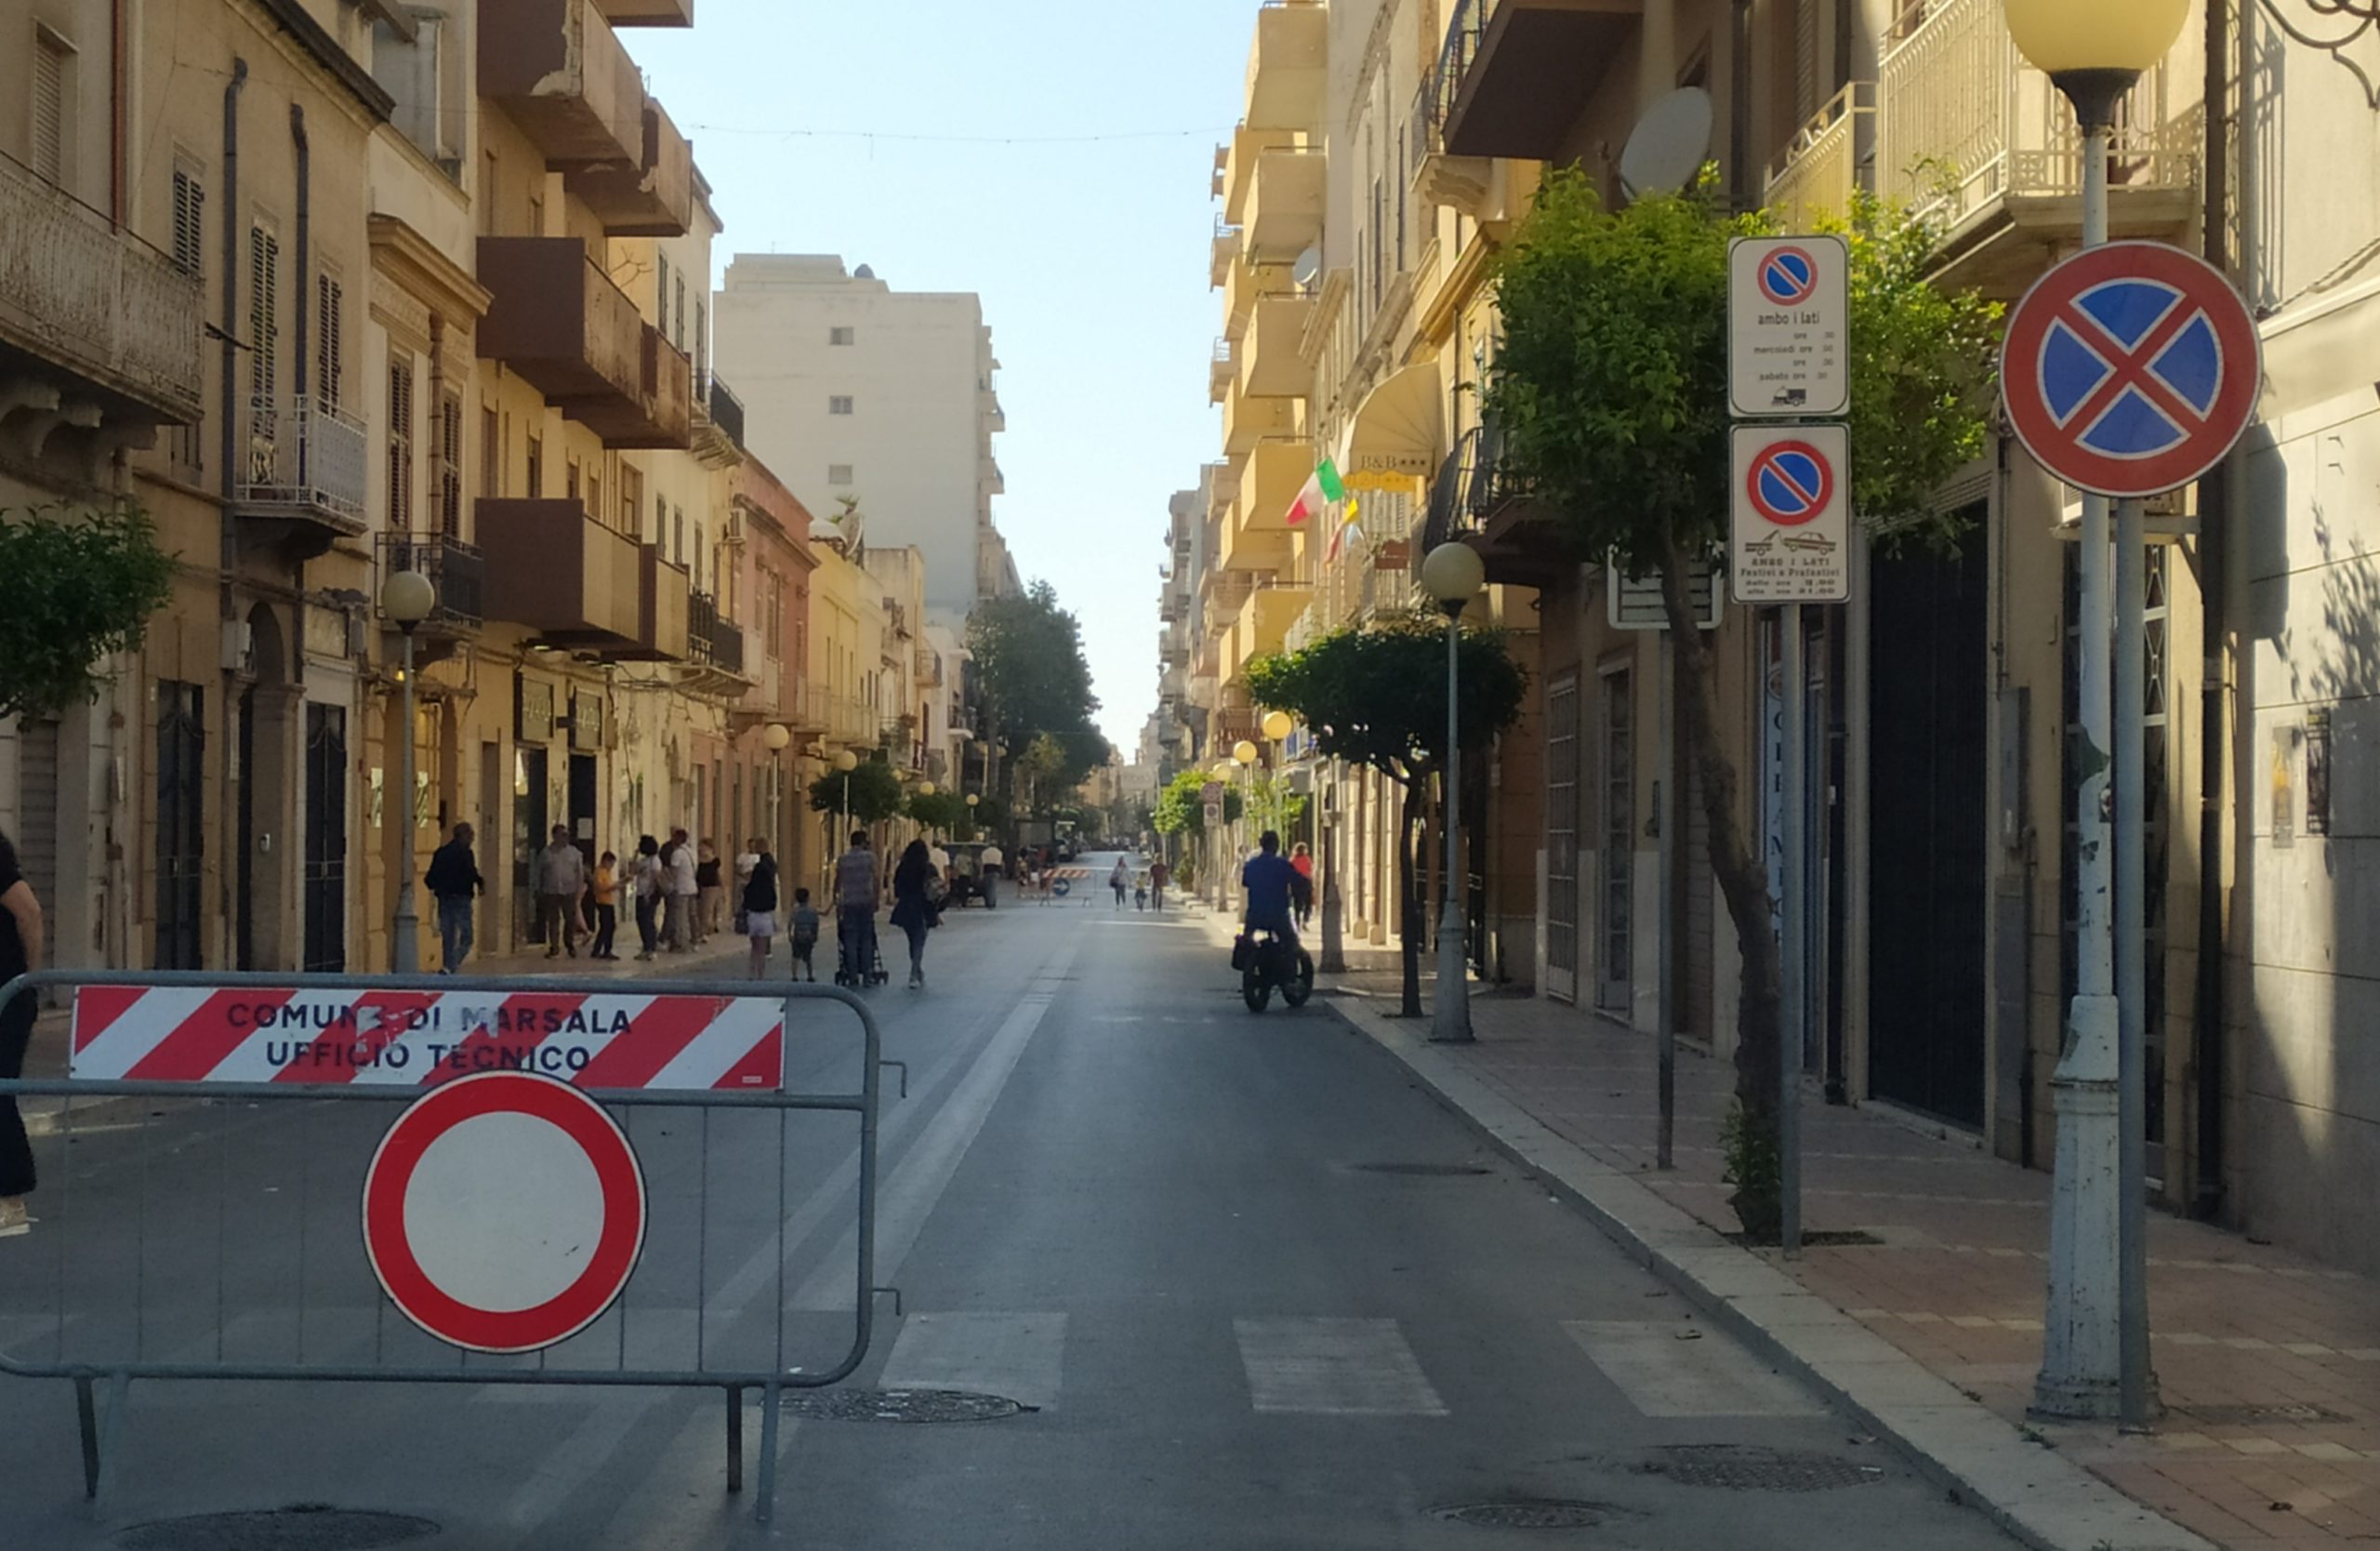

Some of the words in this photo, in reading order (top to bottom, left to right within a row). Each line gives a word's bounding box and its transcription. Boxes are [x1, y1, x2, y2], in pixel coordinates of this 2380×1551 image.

[1758, 312, 1790, 325] ambo
[1801, 312, 1820, 325] lati
[1361, 455, 1397, 469] B&B
[1752, 558, 1783, 566] AMBO
[1803, 558, 1830, 566] LATI
[227, 1002, 388, 1029] COMUNE
[407, 1006, 441, 1031] DI
[461, 1006, 632, 1034] MARSALA
[266, 1041, 409, 1068] UFFICIO
[427, 1044, 590, 1071] TECNICO
